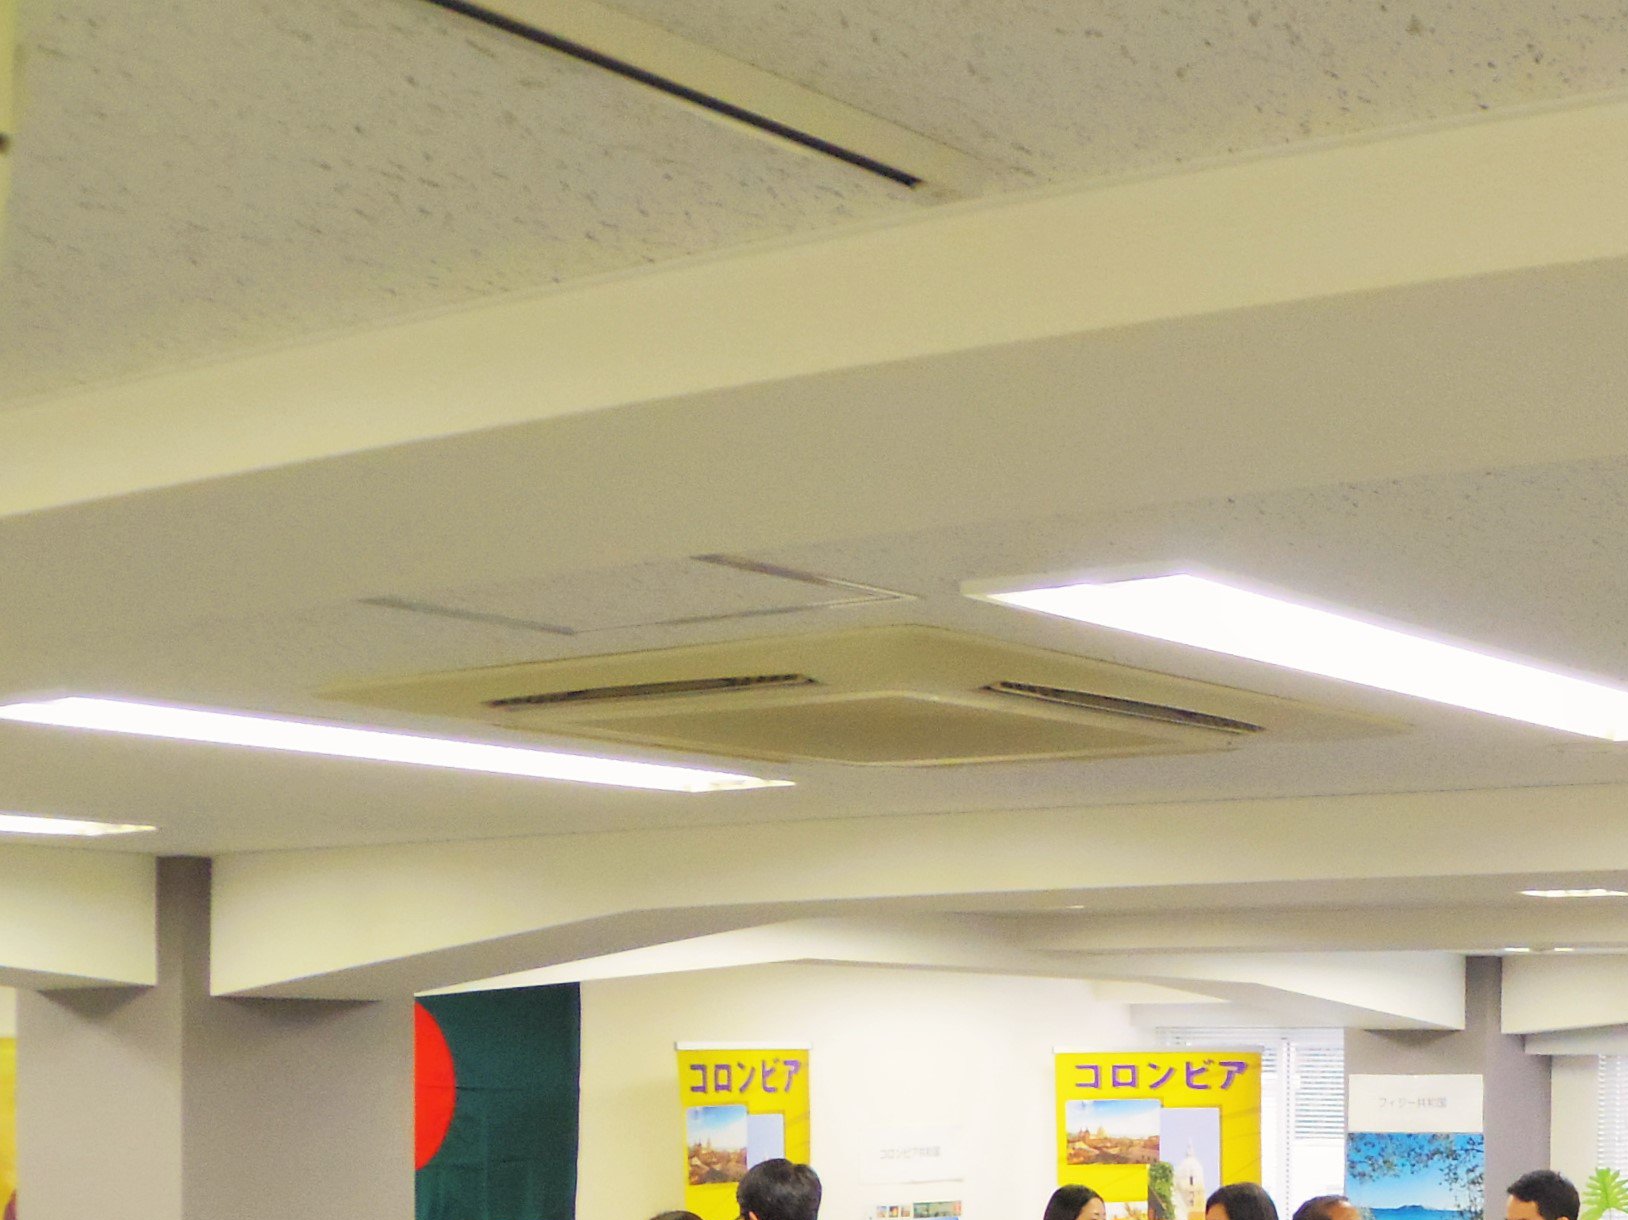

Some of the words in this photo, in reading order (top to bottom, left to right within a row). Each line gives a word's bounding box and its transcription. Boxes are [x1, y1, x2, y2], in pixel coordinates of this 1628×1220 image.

[690, 1058, 801, 1093] コロンビア
[1075, 1059, 1248, 1090] コロンビア
